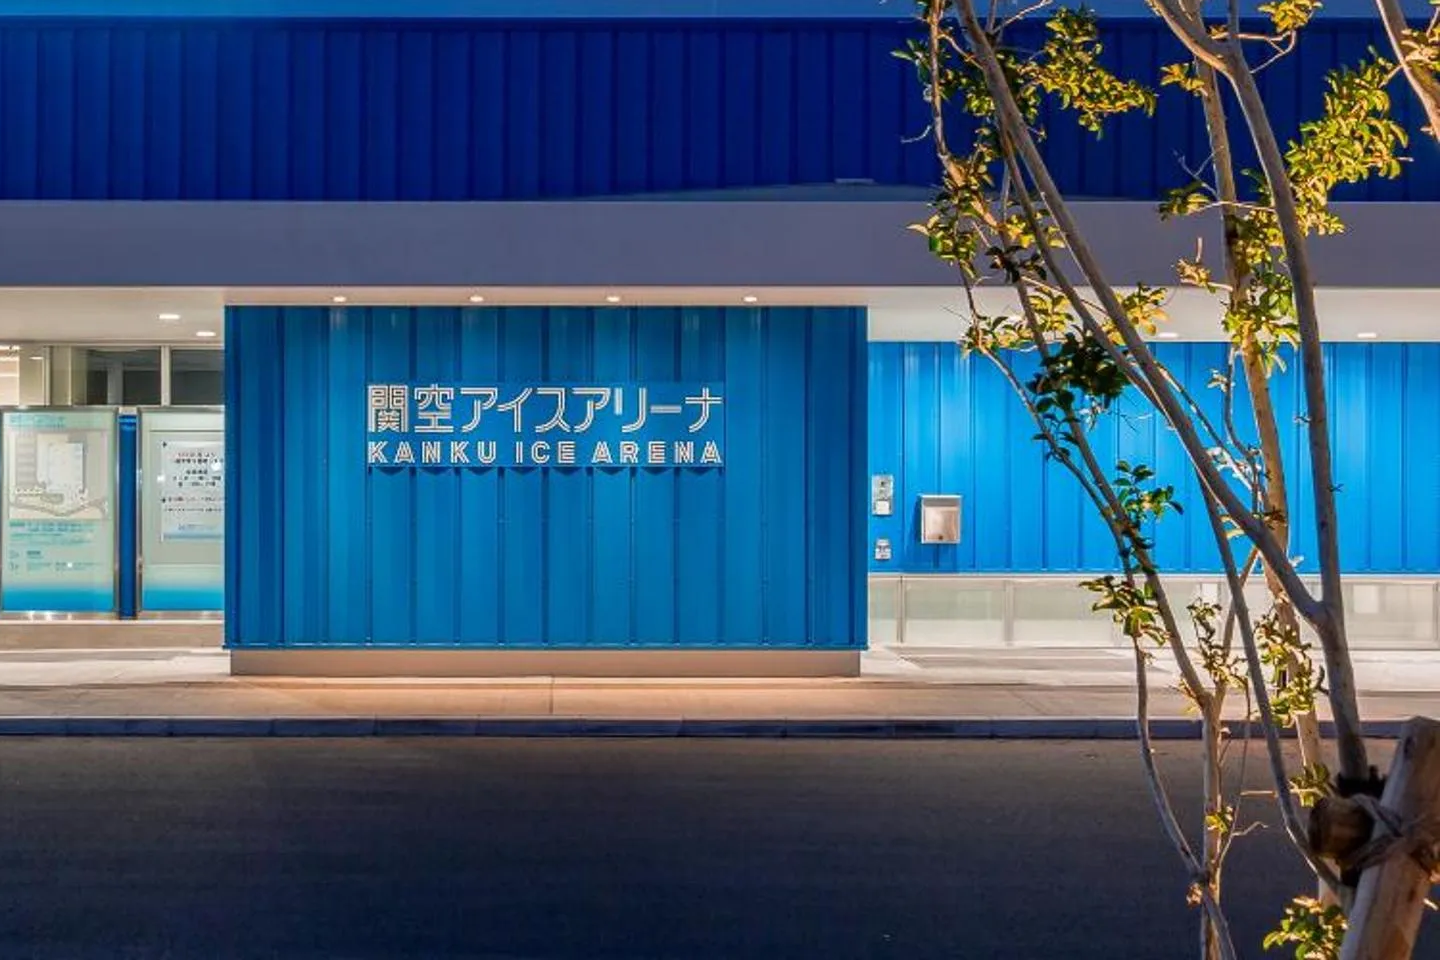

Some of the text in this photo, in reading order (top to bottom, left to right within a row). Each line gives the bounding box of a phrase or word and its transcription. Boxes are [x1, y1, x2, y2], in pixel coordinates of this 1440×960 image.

[367, 384, 722, 433] 関空アイスアリーナ
[367, 440, 723, 464] KANKU ICE ARENA
